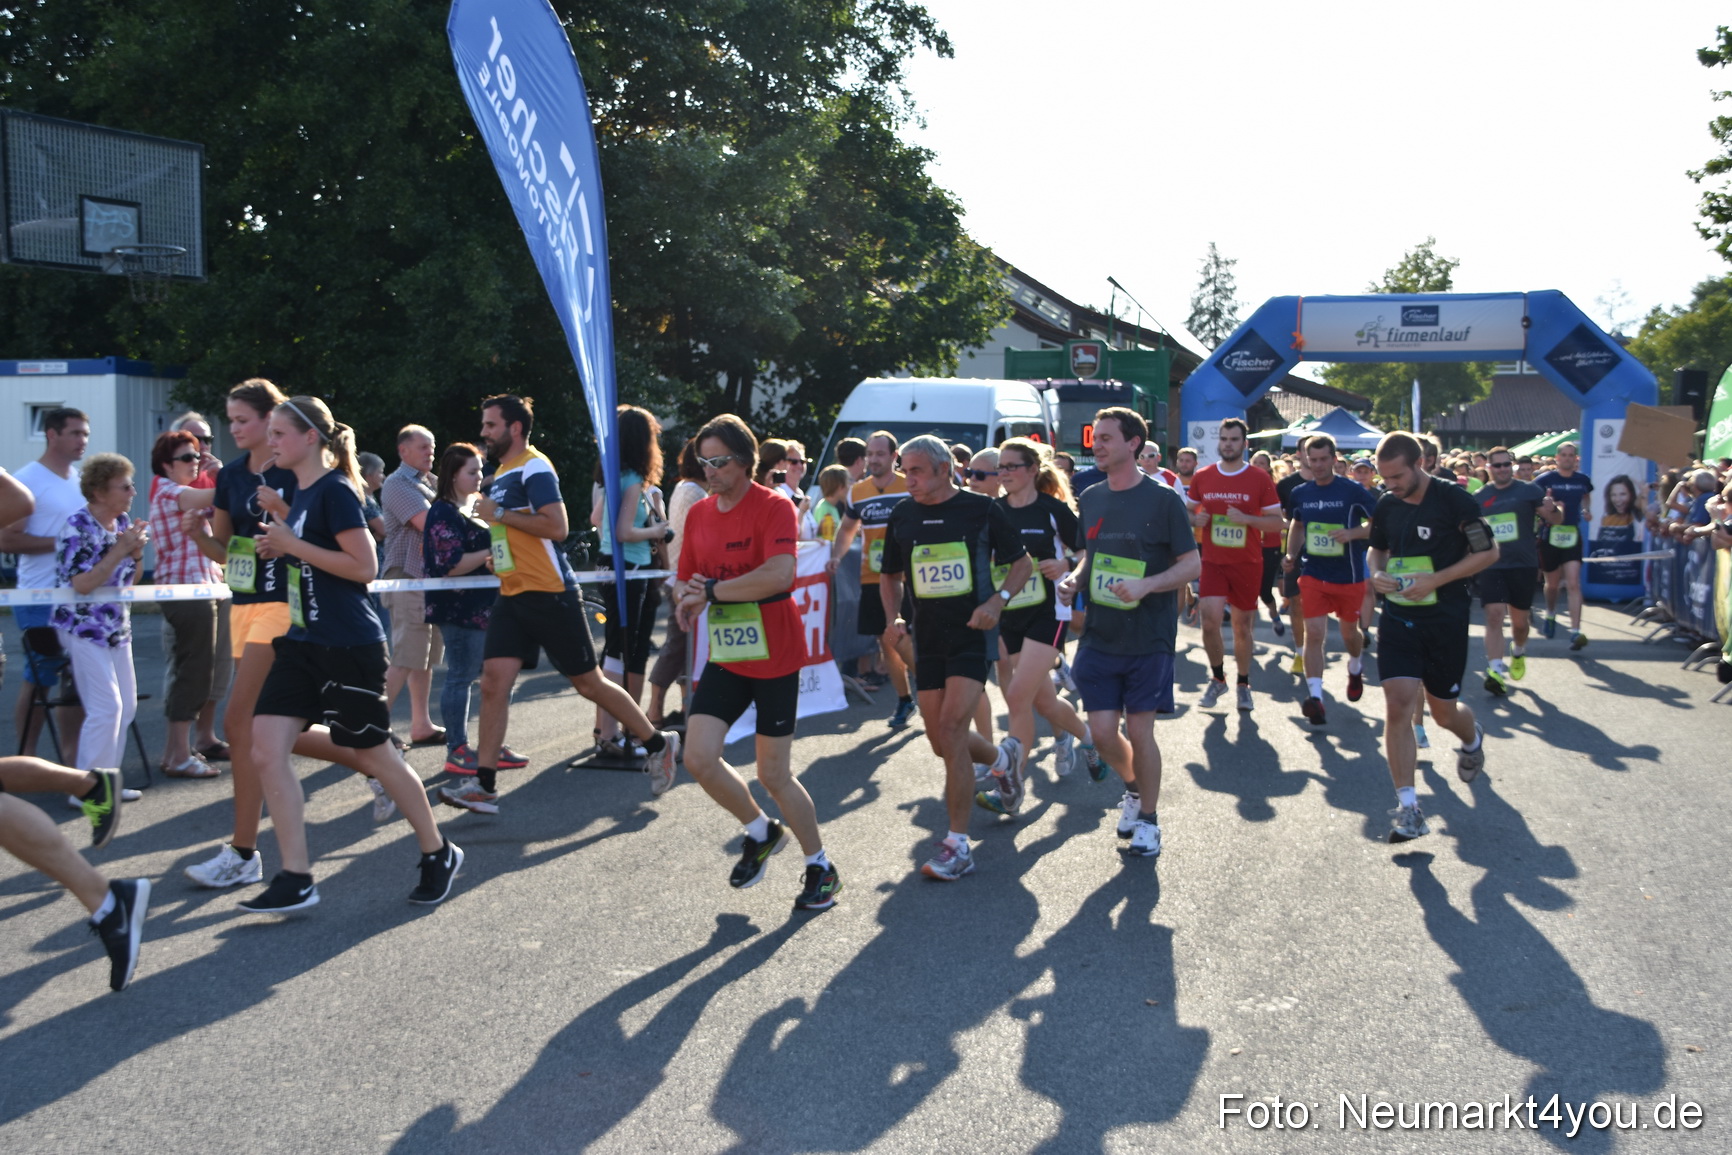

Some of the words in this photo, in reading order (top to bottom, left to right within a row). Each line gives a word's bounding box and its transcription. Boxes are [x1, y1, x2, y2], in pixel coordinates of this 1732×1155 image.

[1387, 326, 1471, 342] firmenlauf
[1231, 357, 1275, 368] Fischer
[1203, 492, 1242, 501] NEUMARKT
[1215, 527, 1243, 539] 1410
[1313, 535, 1336, 548] 391
[228, 558, 254, 578] 1133
[918, 563, 965, 584] 1250
[713, 626, 760, 647] 1529
